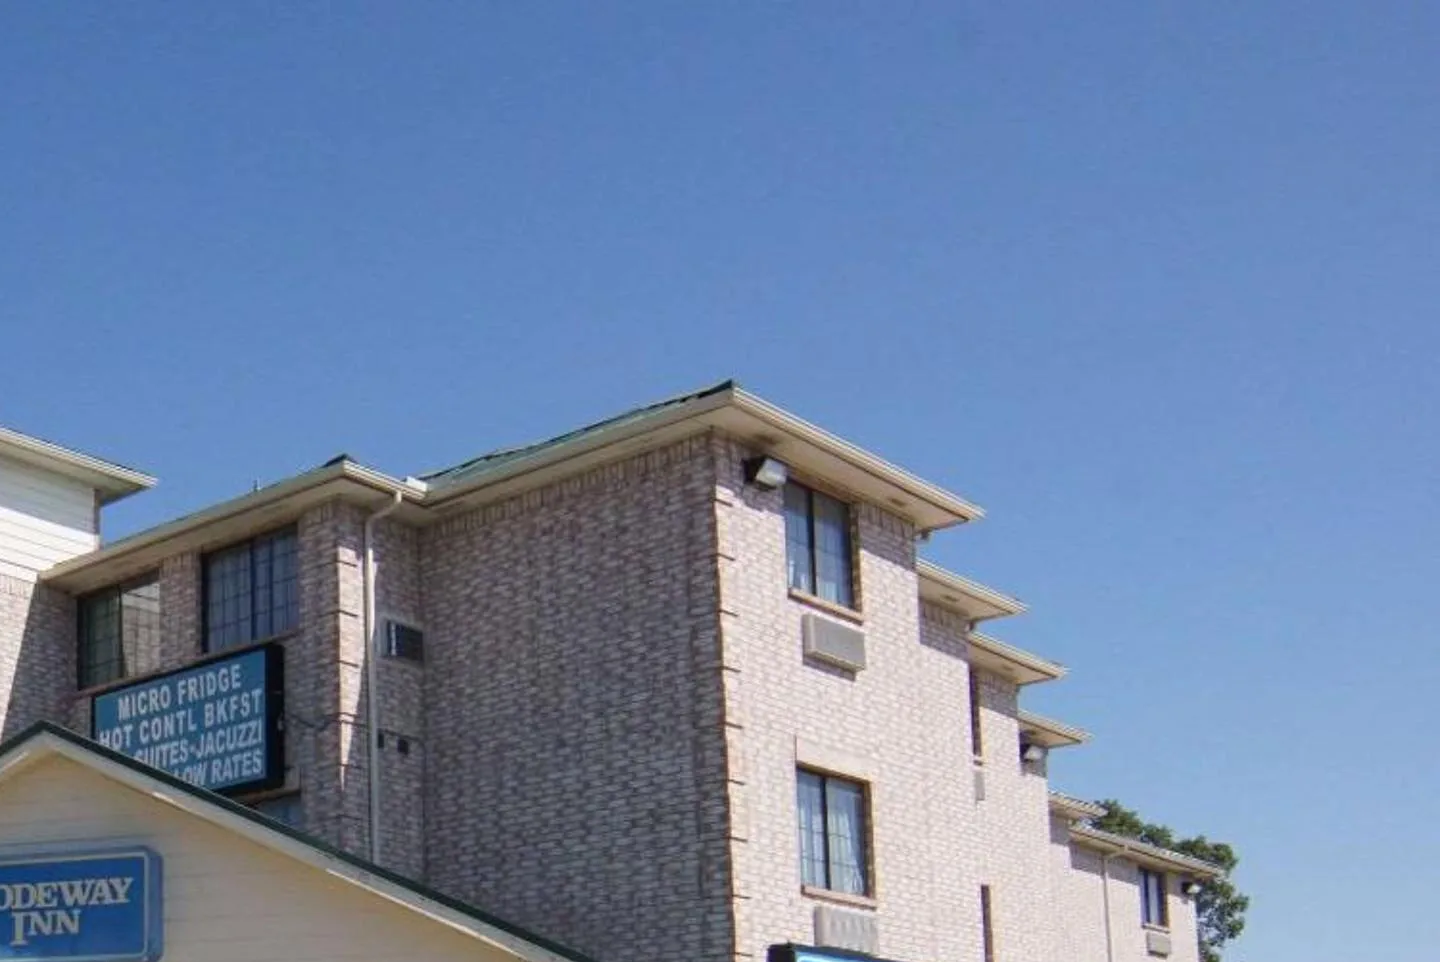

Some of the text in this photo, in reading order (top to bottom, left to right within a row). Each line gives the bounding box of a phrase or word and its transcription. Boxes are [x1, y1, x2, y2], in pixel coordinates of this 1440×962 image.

[118, 664, 241, 720] MICRO FRIDGE
[100, 688, 263, 750] HOT CONTL BKFST
[211, 749, 262, 784] RATES
[10, 909, 82, 946] INN
